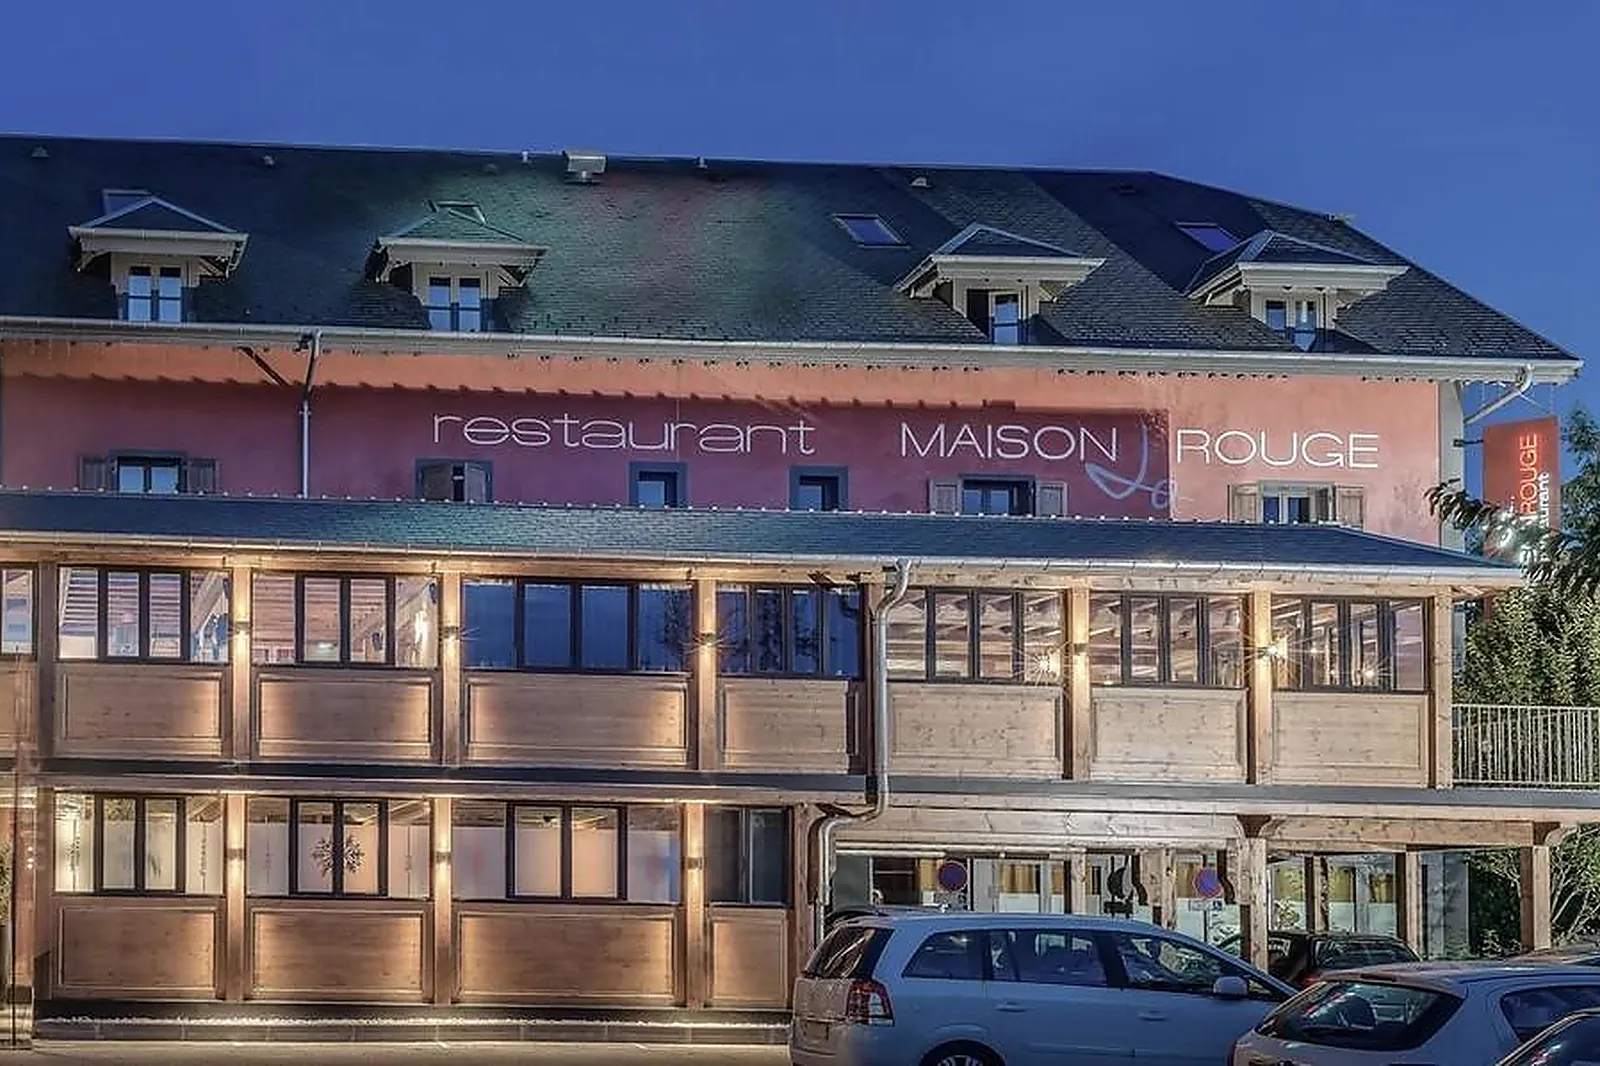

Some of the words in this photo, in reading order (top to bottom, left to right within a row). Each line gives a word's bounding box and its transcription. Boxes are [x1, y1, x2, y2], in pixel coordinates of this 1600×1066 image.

[431, 413, 816, 455] restaurant
[899, 421, 1118, 462] MAISON
[1175, 428, 1381, 470] ROUGE
[1519, 432, 1538, 515] ROUGE
